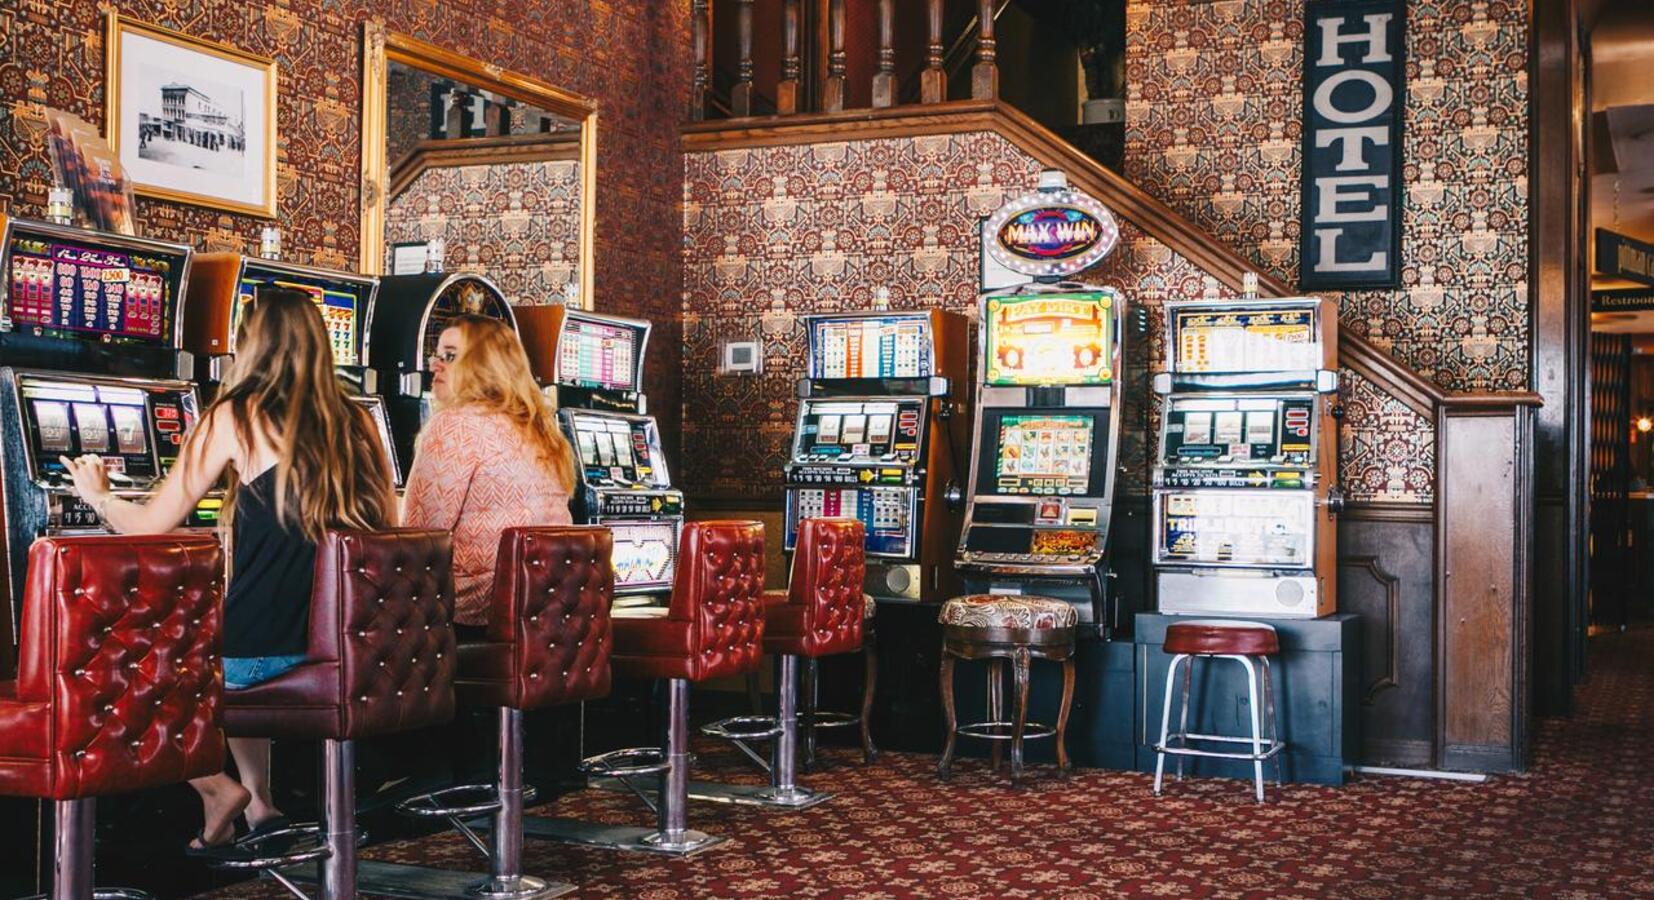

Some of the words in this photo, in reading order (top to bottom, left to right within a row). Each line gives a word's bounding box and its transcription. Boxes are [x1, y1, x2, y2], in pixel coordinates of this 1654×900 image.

[1313, 12, 1394, 273] HOTEL
[1007, 222, 1051, 246] MAX
[1056, 220, 1096, 242] WIN
[104, 271, 123, 280] 2500
